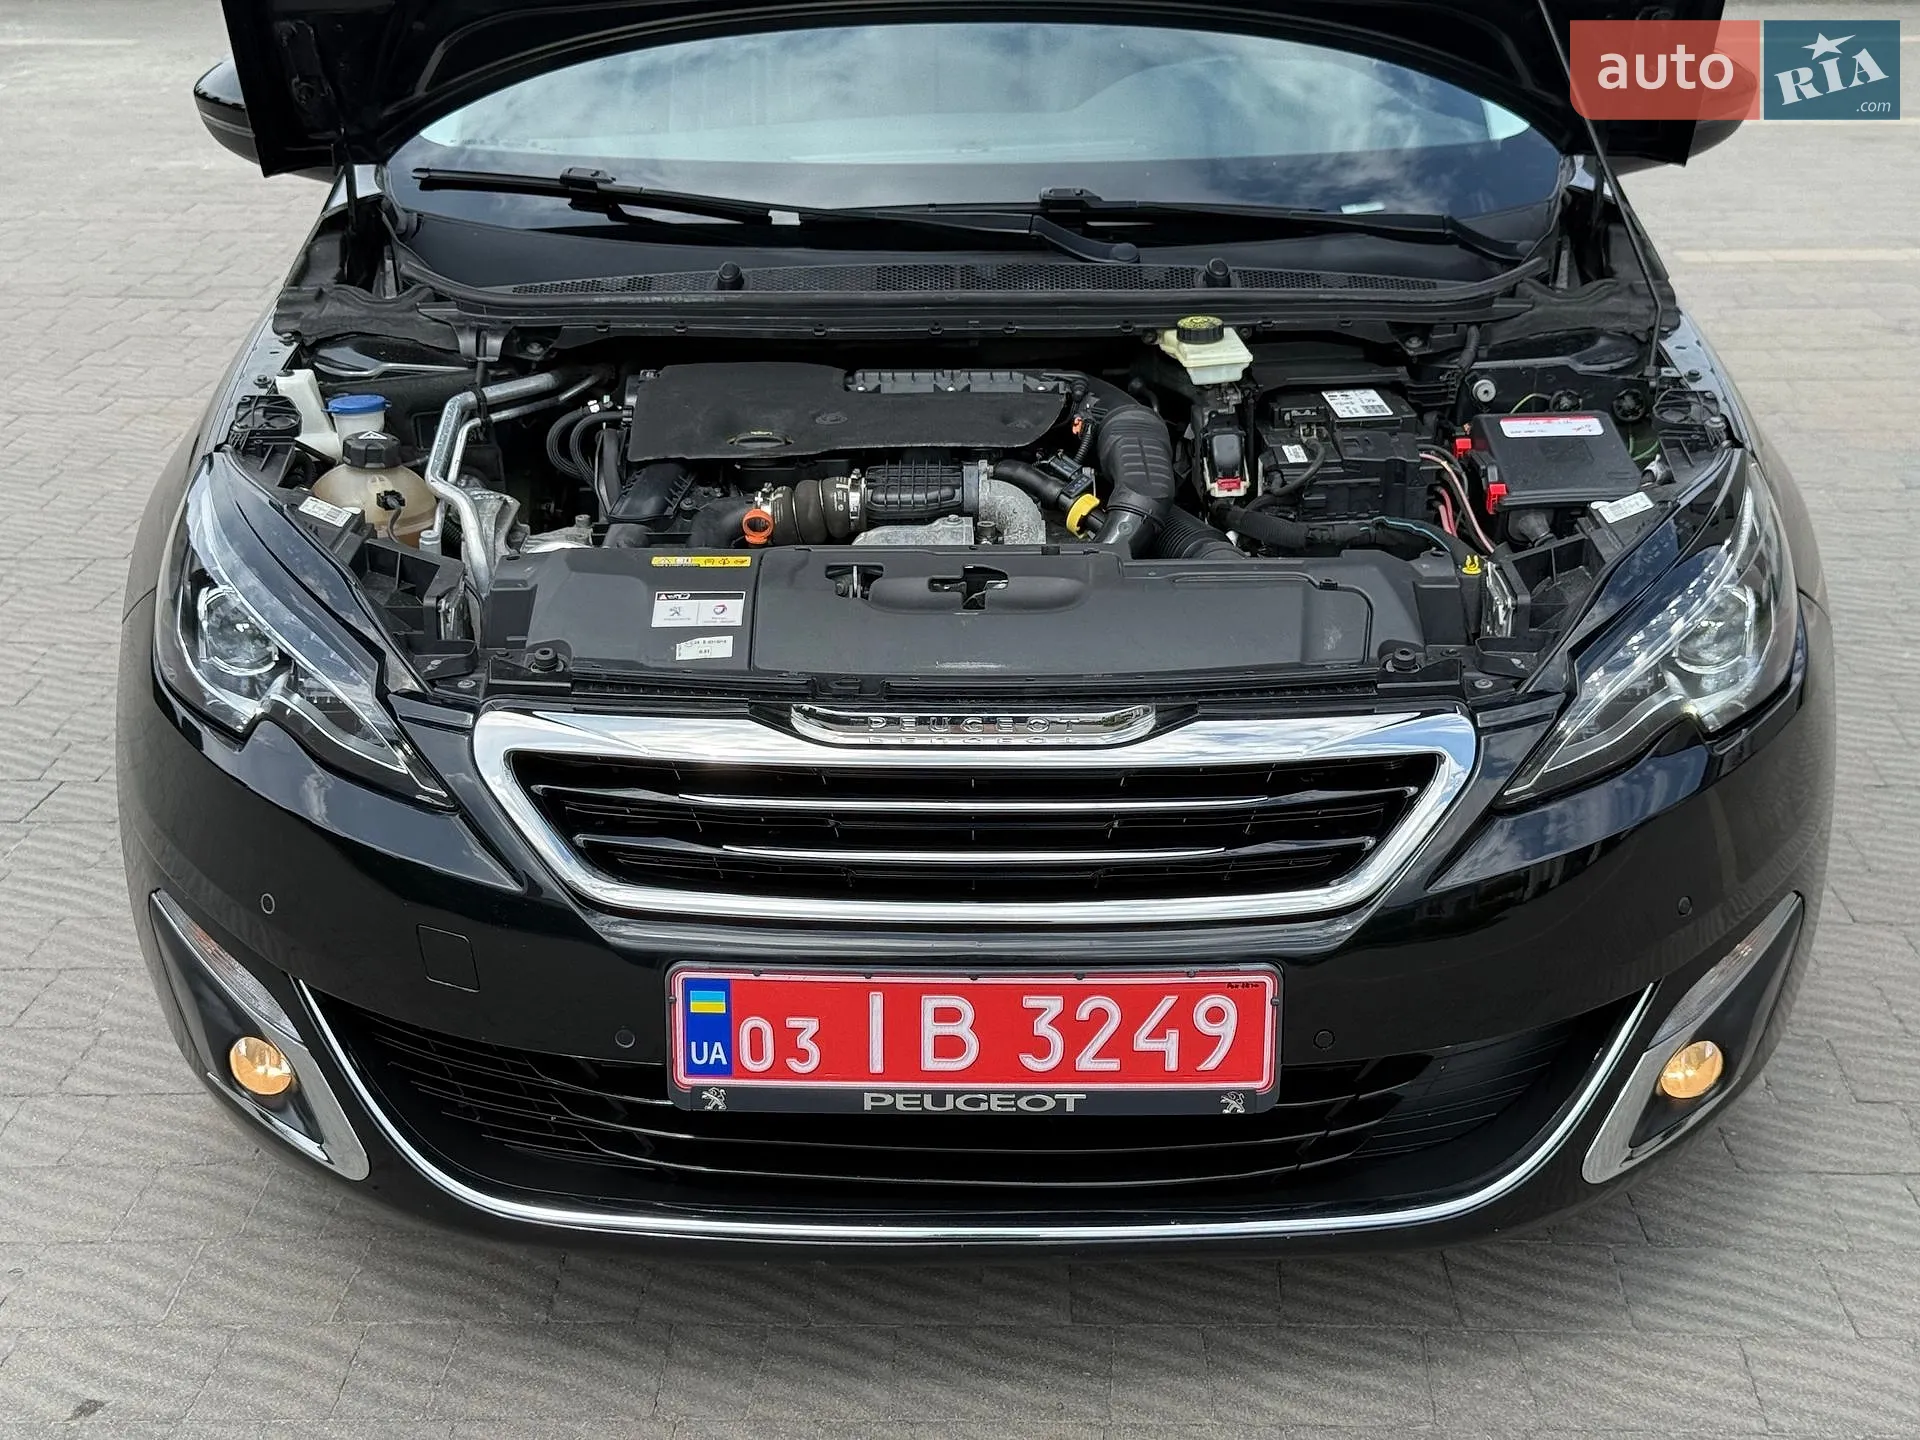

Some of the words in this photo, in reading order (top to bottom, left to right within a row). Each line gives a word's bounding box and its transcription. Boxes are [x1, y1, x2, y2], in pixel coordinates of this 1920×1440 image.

[867, 716, 1081, 733] PEUGEOT
[738, 1016, 822, 1075] 03
[1017, 993, 1239, 1072] 3249
[690, 1040, 727, 1066] UA
[863, 1092, 1087, 1113] PEUGEOT
